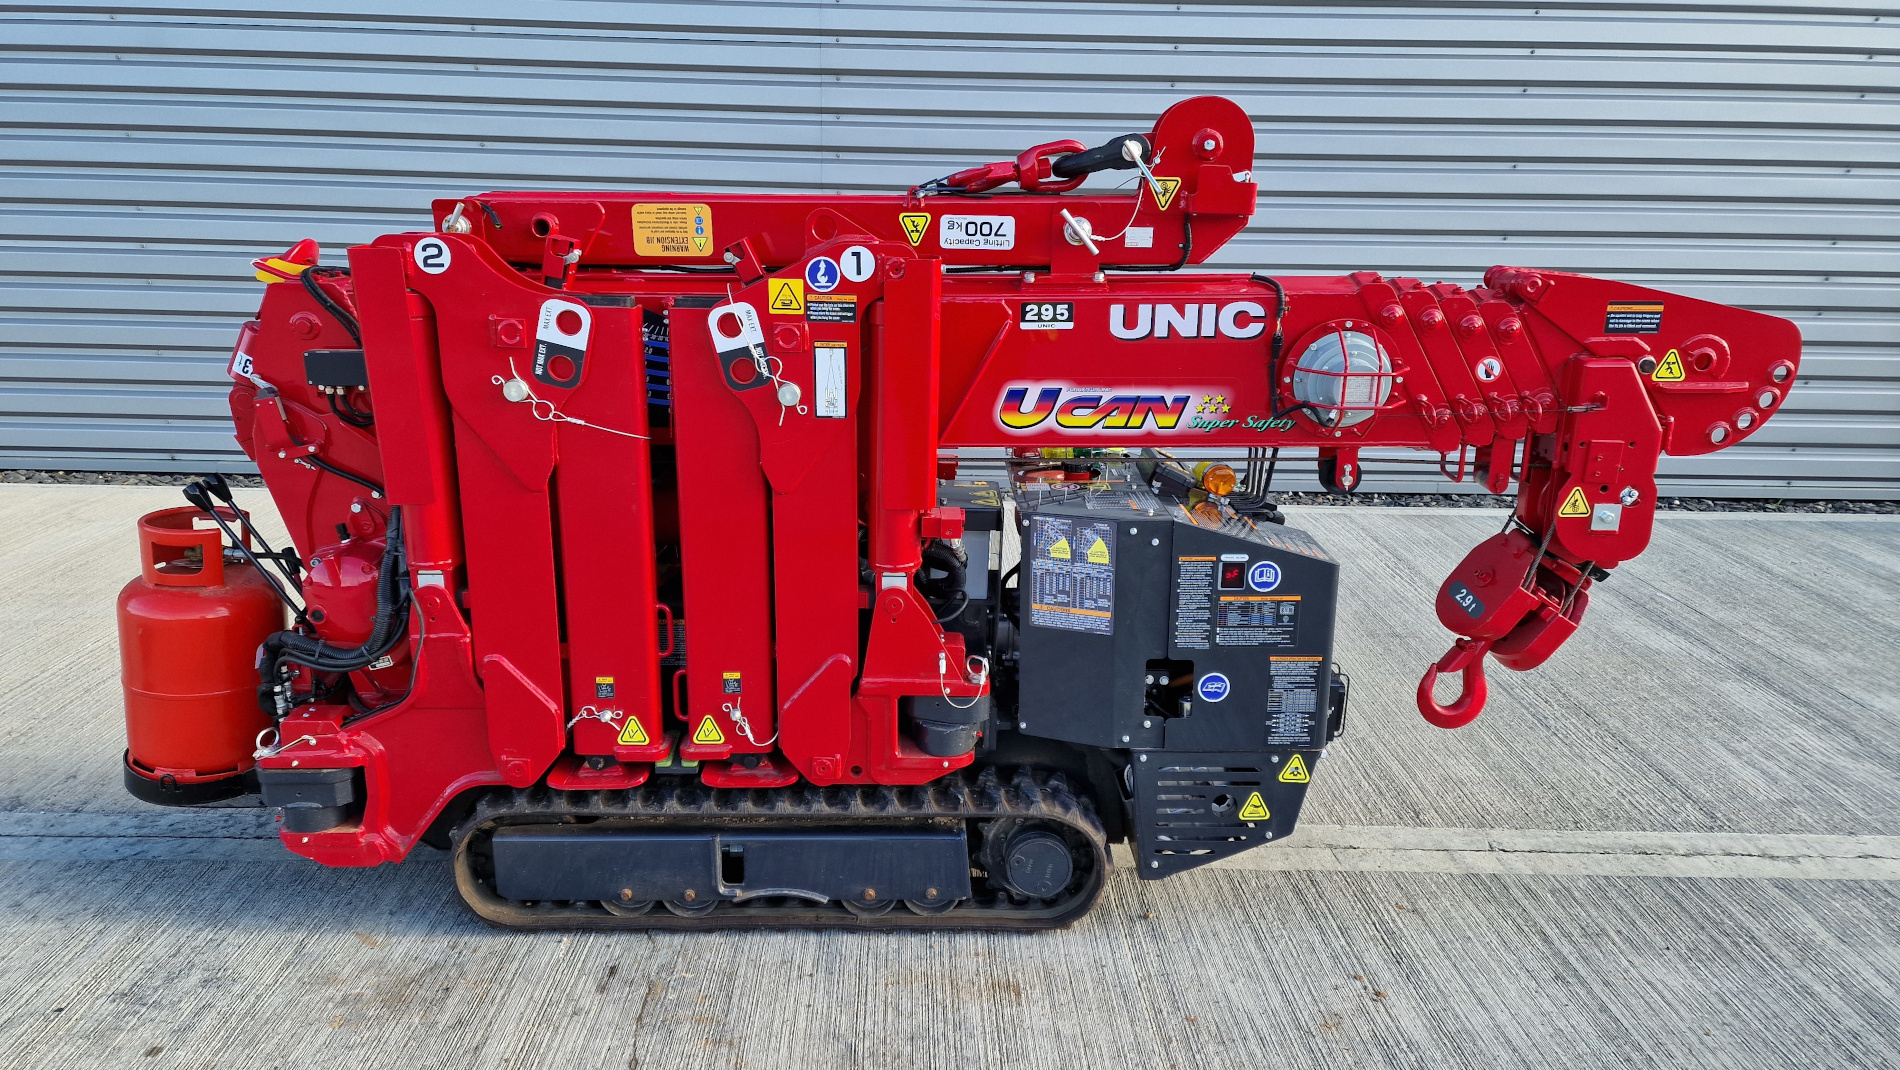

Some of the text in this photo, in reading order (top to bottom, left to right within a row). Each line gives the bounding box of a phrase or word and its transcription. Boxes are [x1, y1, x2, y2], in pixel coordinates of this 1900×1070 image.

[646, 236, 689, 244] EXTENSION JIB
[662, 244, 689, 252] WARNING
[943, 237, 1010, 247] Lifting Capacity
[421, 243, 445, 268] 2
[851, 251, 862, 276] 1
[1025, 304, 1069, 321] 295
[1109, 301, 1267, 340] UNIC
[543, 318, 551, 330] MAX
[1186, 415, 1297, 433] Super Safety
[1455, 588, 1474, 607] 2.9
